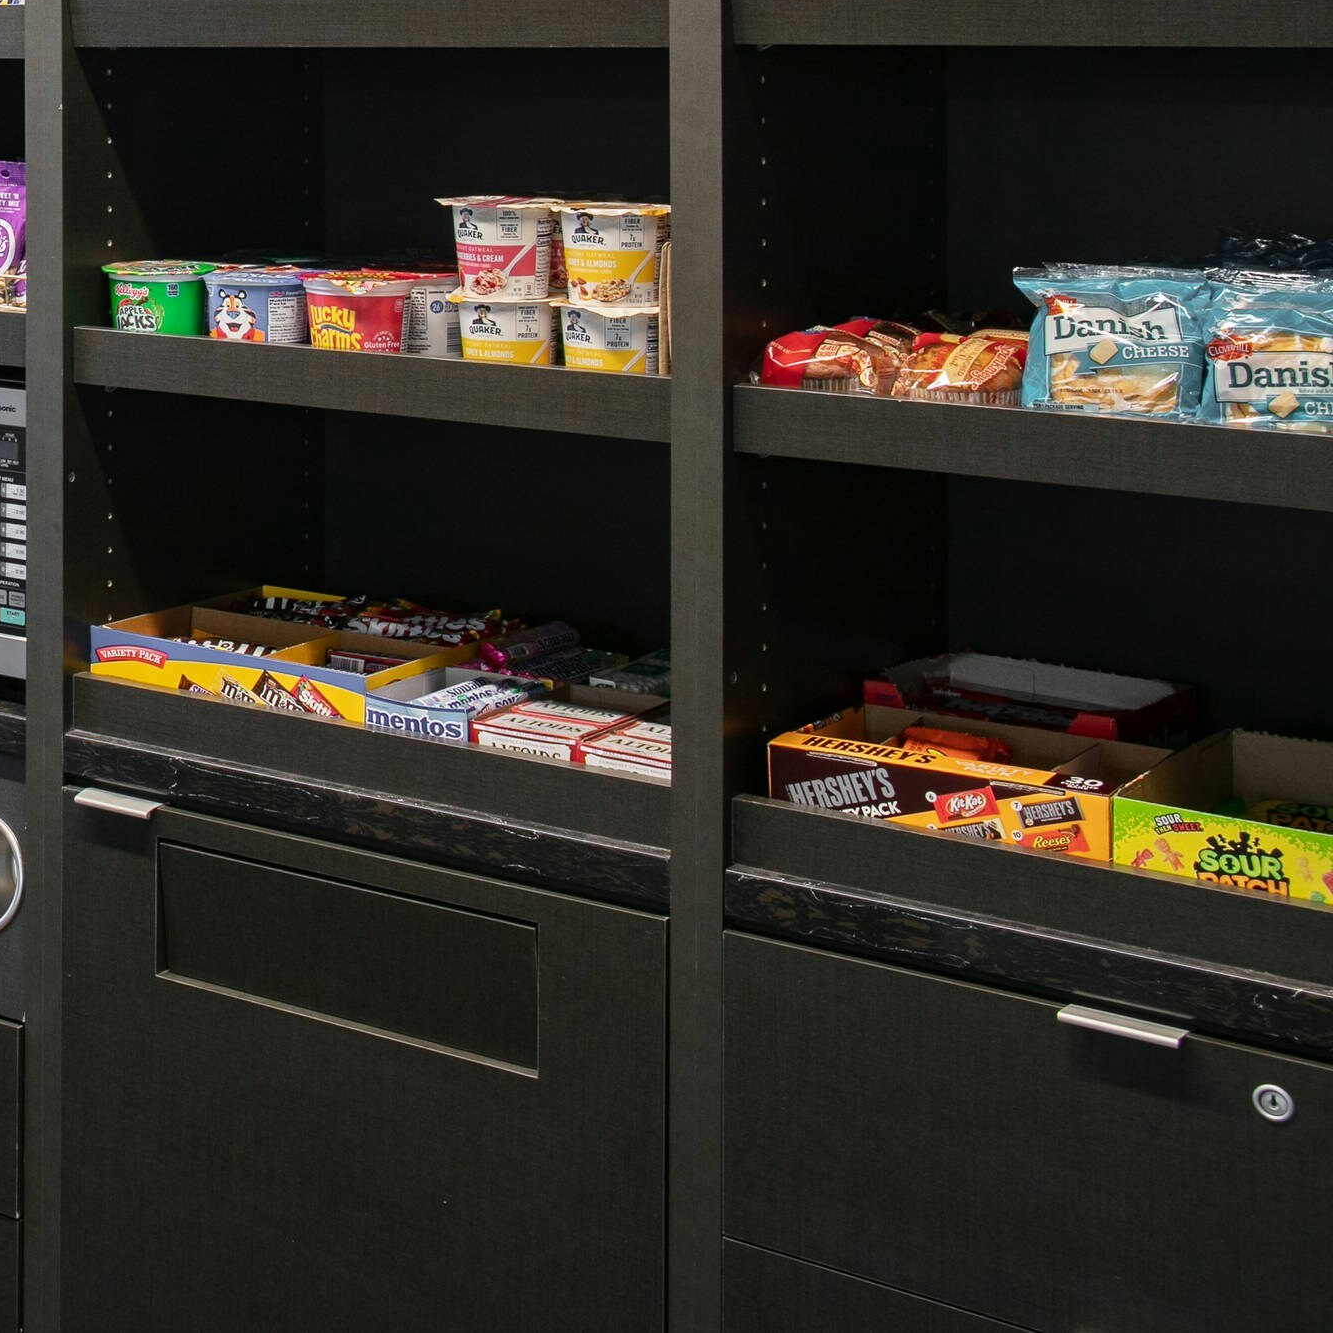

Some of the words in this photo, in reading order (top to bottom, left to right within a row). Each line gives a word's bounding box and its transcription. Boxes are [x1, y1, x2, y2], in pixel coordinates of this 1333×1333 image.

[457, 229, 483, 240] QUAKER
[571, 234, 605, 245] QUAKER
[477, 253, 482, 262] &
[482, 254, 504, 263] CREAM
[586, 260, 617, 268] ALMONDS
[115, 283, 149, 298] Kellogg's
[118, 306, 145, 316] APPLE
[116, 315, 156, 331] JACKS
[469, 325, 502, 336] QUAKER
[1054, 316, 1168, 341] Danish
[364, 341, 387, 349] Gluten
[566, 332, 591, 343] QUAKER
[606, 340, 630, 348] PROTEIN
[484, 350, 515, 359] ALMONDS
[1122, 344, 1190, 360] CHEESE
[1228, 360, 1333, 388] Danis
[100, 648, 139, 659] VARIETY
[139, 650, 163, 664] PACK
[298, 691, 333, 717] Skittl
[367, 707, 463, 739] mentos
[502, 716, 584, 733] ALTOIDS
[609, 737, 671, 754] ALTOI
[802, 736, 937, 764] HERSHEY'S
[955, 759, 1035, 776] VARIETY
[964, 765, 1013, 778] PACK
[788, 768, 896, 808] HERSHEY'S
[1069, 776, 1104, 788] 30
[861, 801, 902, 818] PACK
[1024, 800, 1076, 820] HERSHEY'S
[1155, 813, 1183, 826] SOUR
[1155, 824, 1173, 834] THEN
[1172, 823, 1202, 832] SWEET
[1199, 848, 1283, 880] SOUR
